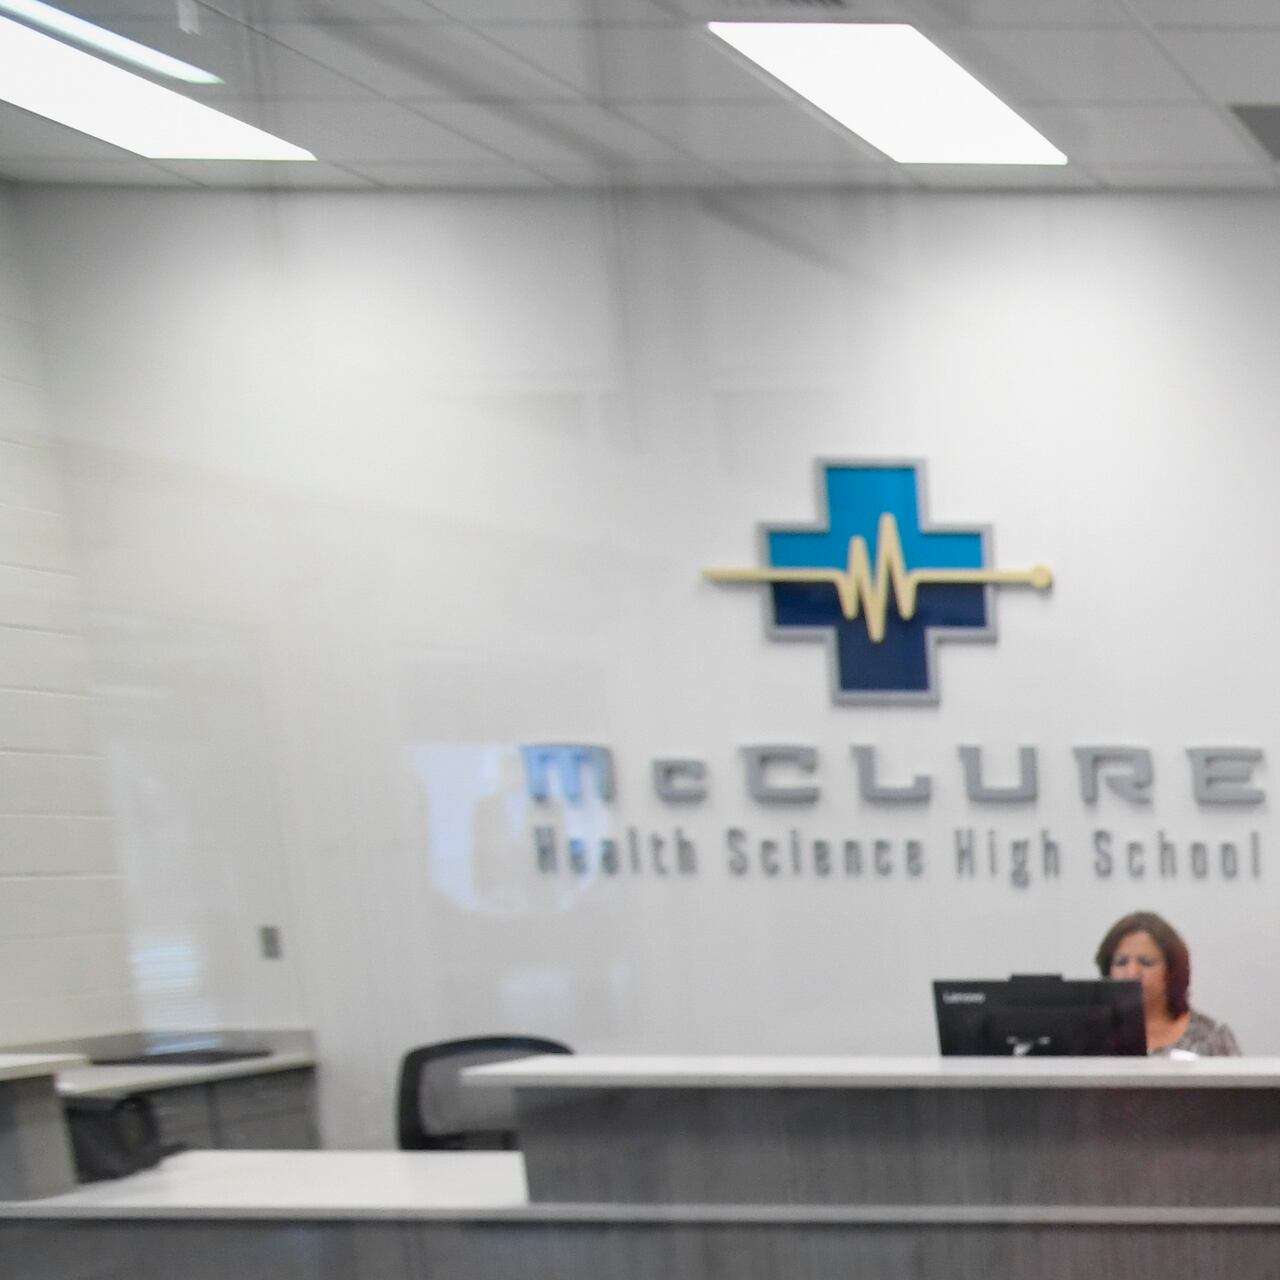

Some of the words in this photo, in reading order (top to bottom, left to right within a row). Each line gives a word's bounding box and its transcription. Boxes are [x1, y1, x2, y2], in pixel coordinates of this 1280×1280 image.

[521, 744, 1266, 804] McCLURE
[535, 825, 698, 876] Health
[726, 825, 925, 878] Science
[953, 828, 1061, 889] High
[1091, 829, 1261, 879] School
